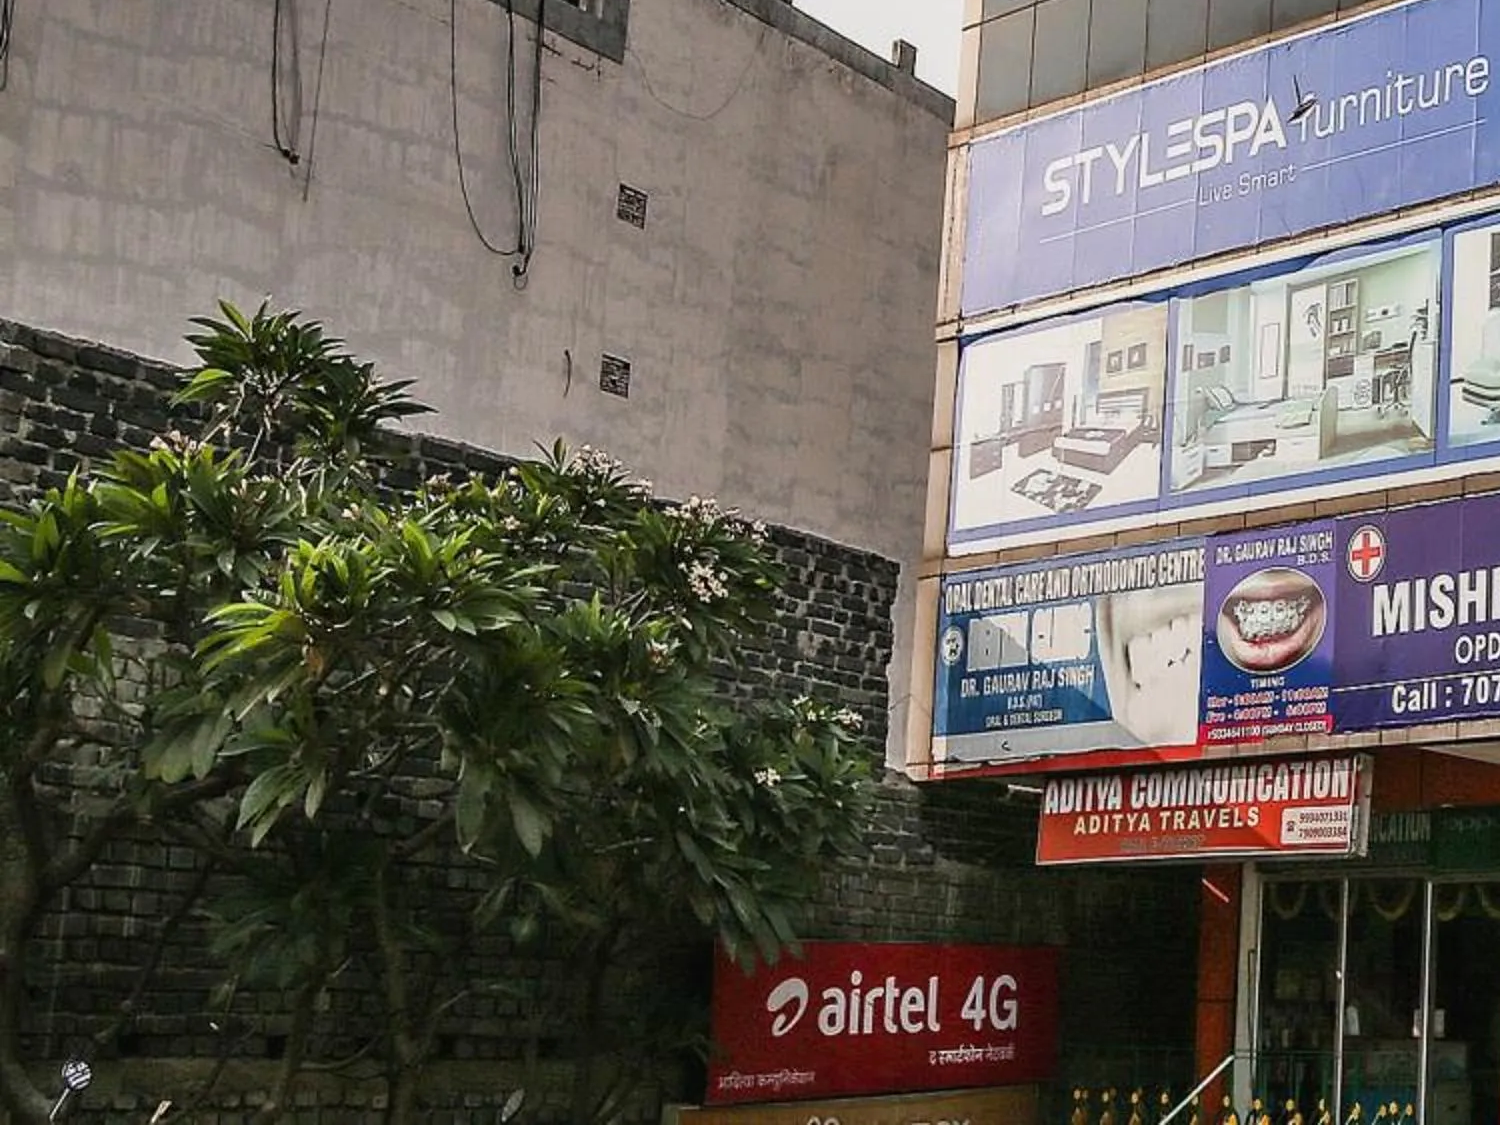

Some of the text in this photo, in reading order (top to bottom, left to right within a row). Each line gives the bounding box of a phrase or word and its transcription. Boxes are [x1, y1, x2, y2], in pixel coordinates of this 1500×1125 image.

[1040, 53, 1490, 218] STYLESPA furniture
[1199, 164, 1298, 206] Live Smart
[1235, 540, 1277, 563] GAURAV
[1300, 531, 1333, 553] SINGH
[973, 575, 1013, 612] DENTAL
[1016, 571, 1045, 605] CARE
[1045, 566, 1070, 600] AND
[1071, 554, 1157, 597] ORTHODONTIC
[1158, 547, 1205, 586] CENTRE
[983, 669, 1030, 696] GAURAV
[1032, 667, 1055, 689] RAJ
[1058, 664, 1095, 687] SINGH
[1391, 682, 1437, 714] Call
[1044, 759, 1351, 814] ADITYA COMMUNICATION
[1074, 807, 1260, 835] ADITYA TRAVELS
[817, 970, 1018, 1036] airtel 4G
